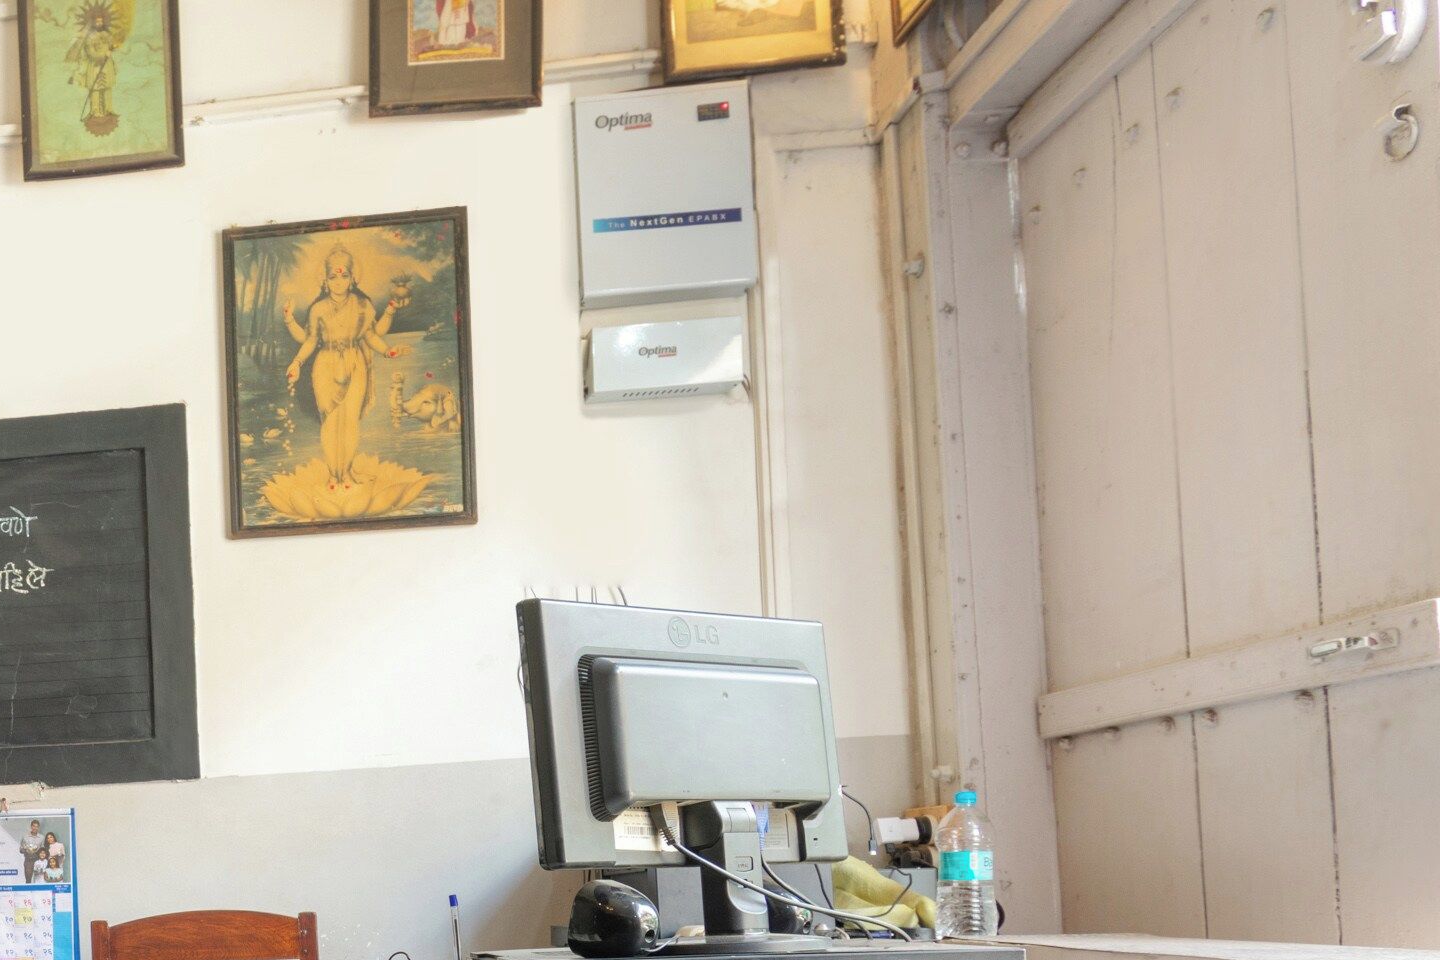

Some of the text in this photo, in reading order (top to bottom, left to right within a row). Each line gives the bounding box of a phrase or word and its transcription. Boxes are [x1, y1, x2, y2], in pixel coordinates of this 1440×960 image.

[595, 112, 653, 131] Optima
[630, 216, 684, 228] NextGen
[688, 213, 727, 223] EPABX
[638, 345, 678, 358] Optima
[694, 624, 720, 646] LG
